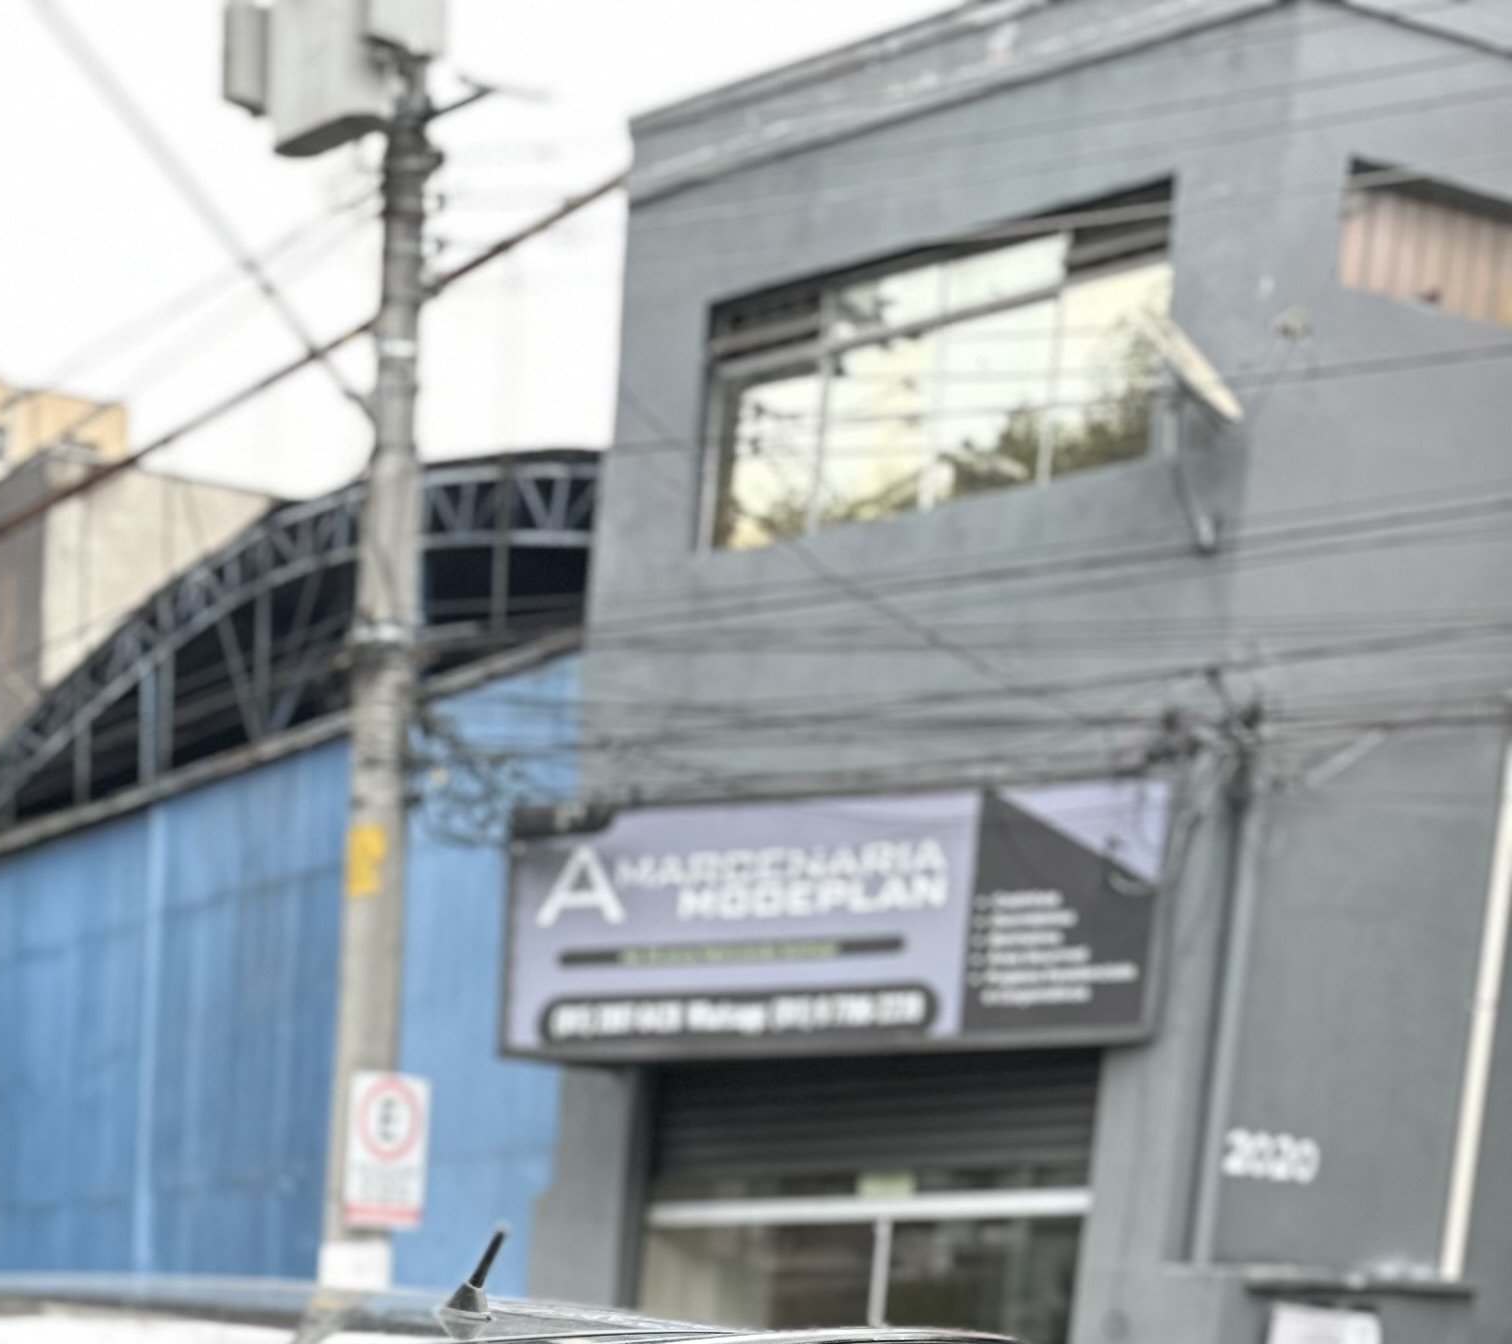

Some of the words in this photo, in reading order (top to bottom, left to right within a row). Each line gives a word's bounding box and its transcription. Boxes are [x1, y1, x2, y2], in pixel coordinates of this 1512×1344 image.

[618, 838, 949, 889] MARCENARIA
[376, 1096, 400, 1143] E
[1222, 1127, 1322, 1184] 2020
